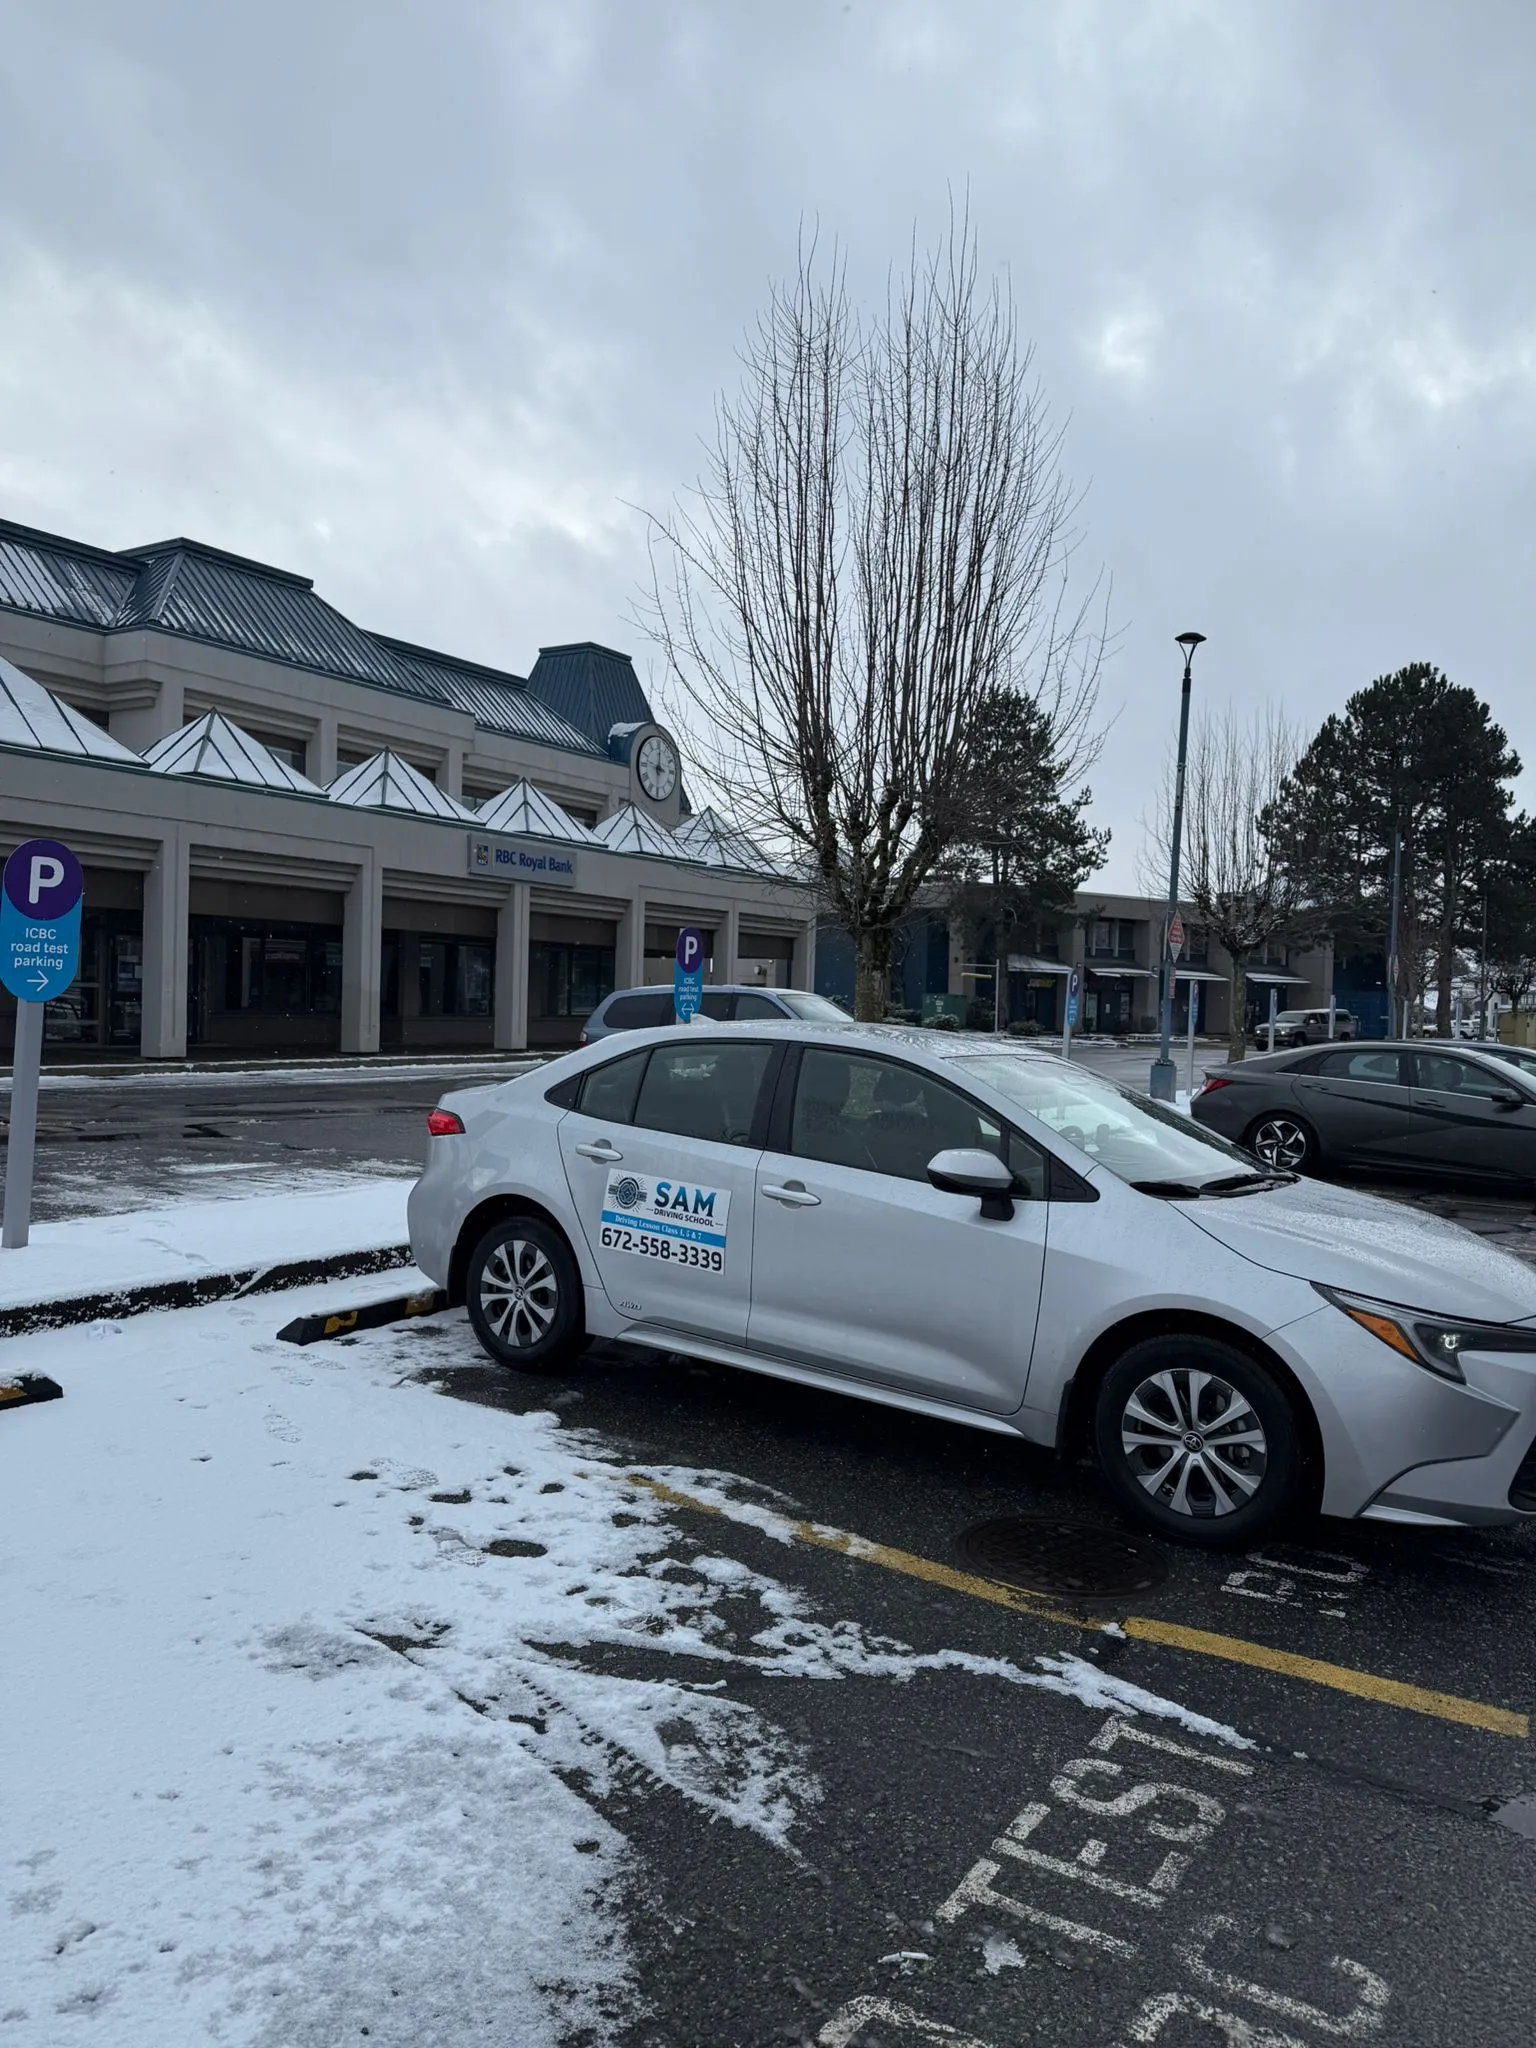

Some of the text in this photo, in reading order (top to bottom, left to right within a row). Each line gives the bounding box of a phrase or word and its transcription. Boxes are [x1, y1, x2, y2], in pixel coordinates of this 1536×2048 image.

[495, 849, 573, 874] RBC Royal Bank
[28, 855, 65, 904] P
[25, 927, 57, 940] ICBC
[10, 941, 69, 954] road test
[684, 935, 699, 965] P
[14, 955, 64, 970] parking
[654, 1181, 717, 1218] SAM
[615, 1215, 638, 1227] Driving
[639, 1220, 660, 1231] Lesson
[662, 1225, 678, 1234] Class
[690, 1231, 697, 1240] &
[654, 1208, 715, 1227] DRIVING SCHOOL
[601, 1227, 723, 1272] 672-558-3339
[935, 1713, 1255, 1961] TEST
